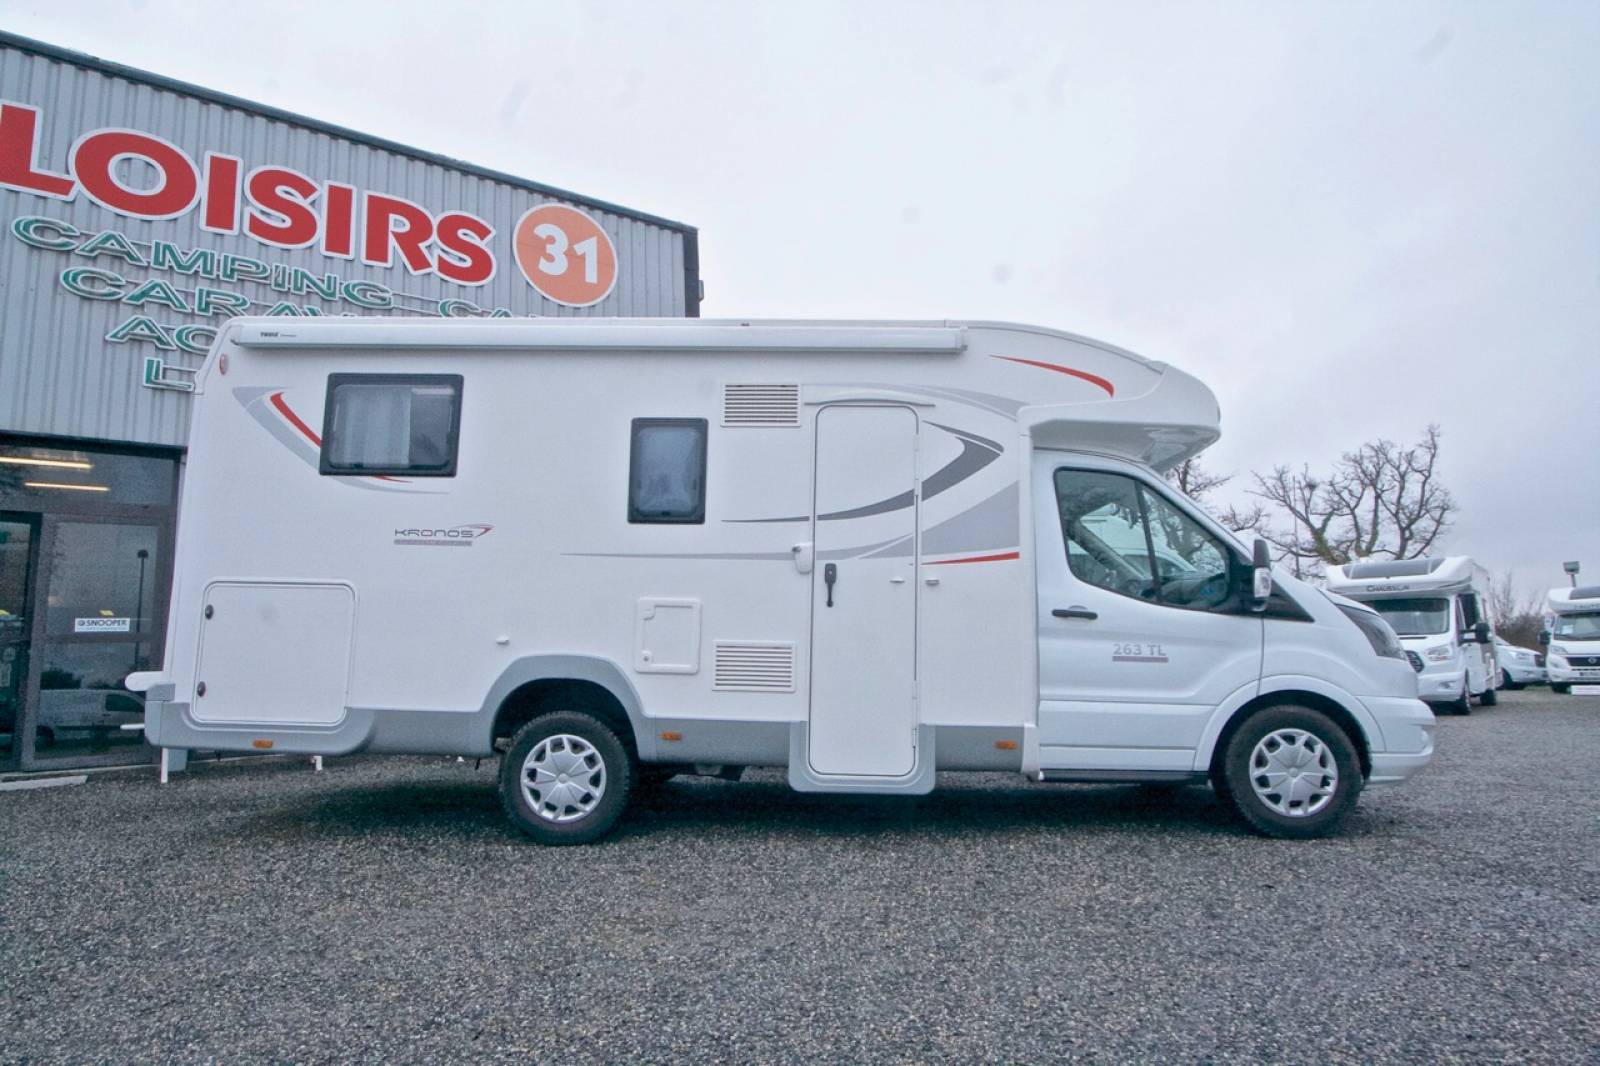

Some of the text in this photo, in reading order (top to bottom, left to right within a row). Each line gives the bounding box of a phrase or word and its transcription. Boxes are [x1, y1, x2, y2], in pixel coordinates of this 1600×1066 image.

[0, 101, 598, 287] LOISIRS 31
[11, 215, 394, 310] CAMPING
[394, 528, 474, 538] KRONOS
[86, 619, 127, 627] SNOOPER
[1112, 643, 1167, 656] 263 TL
